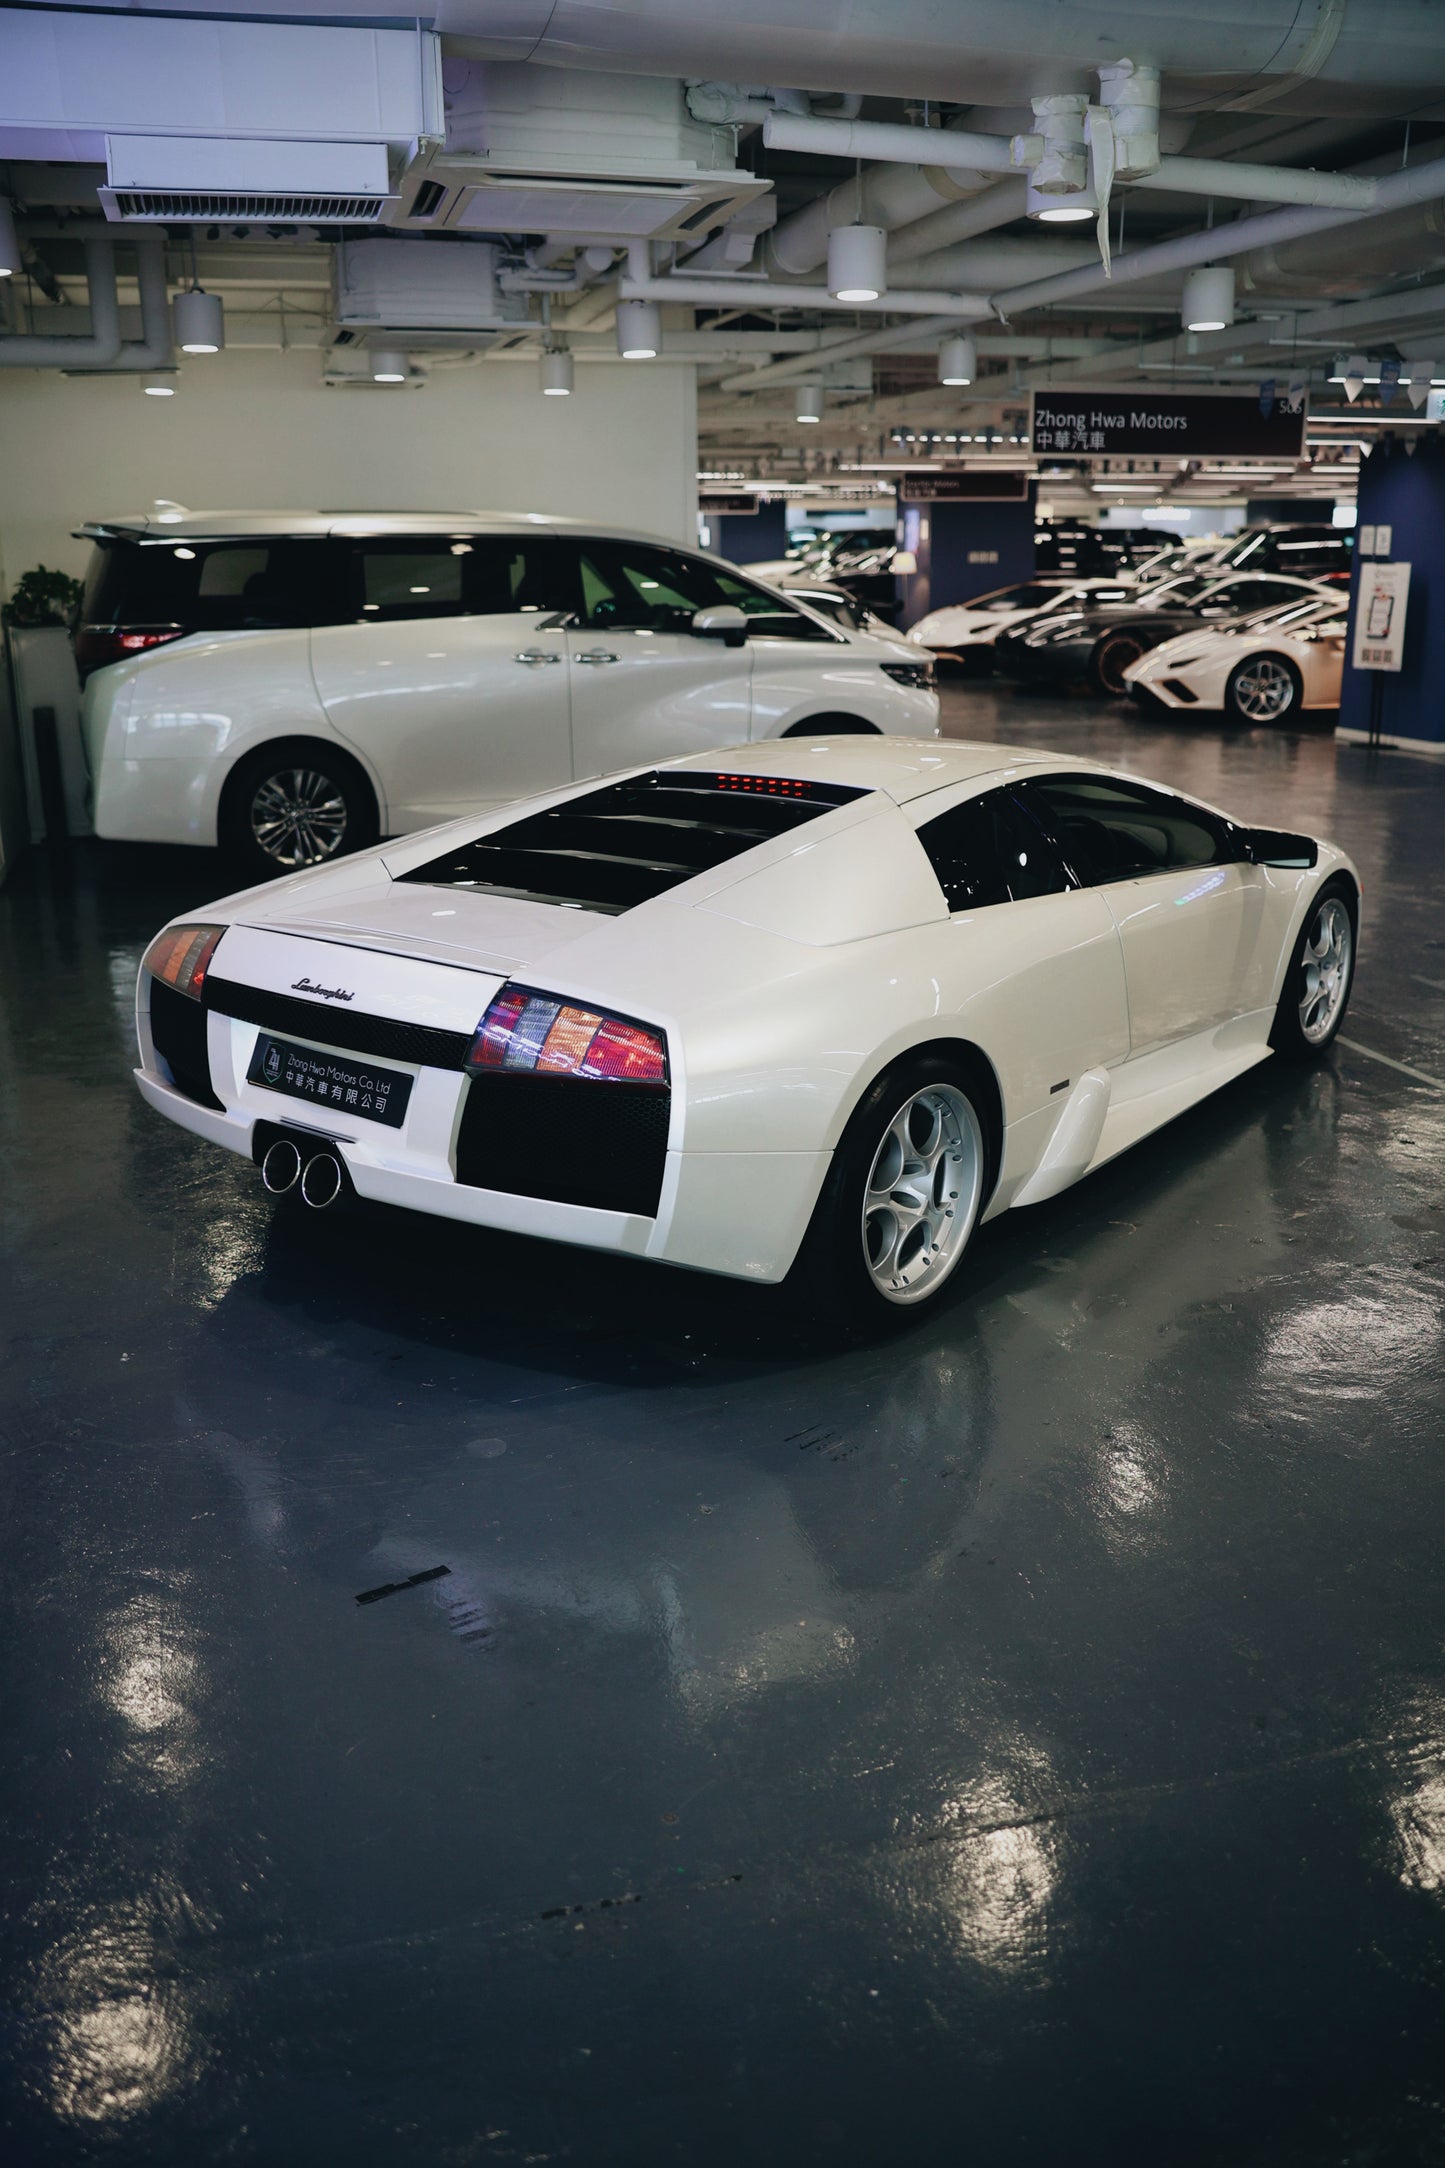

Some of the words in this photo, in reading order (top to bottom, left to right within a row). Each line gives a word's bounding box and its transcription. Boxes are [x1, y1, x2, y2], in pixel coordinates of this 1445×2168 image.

[1035, 410, 1086, 431] Zhong
[1090, 411, 1126, 428] Hwa
[1130, 412, 1188, 429] Motors
[1036, 431, 1106, 450] 中華汽車
[291, 978, 355, 1001] Lamborghini
[288, 1053, 308, 1073] Zhong
[309, 1060, 326, 1077] Hwa
[326, 1065, 357, 1086] Motors
[358, 1075, 374, 1090] Co.
[375, 1080, 391, 1095] Ltd
[285, 1070, 387, 1113] 中華汽車有限公司
